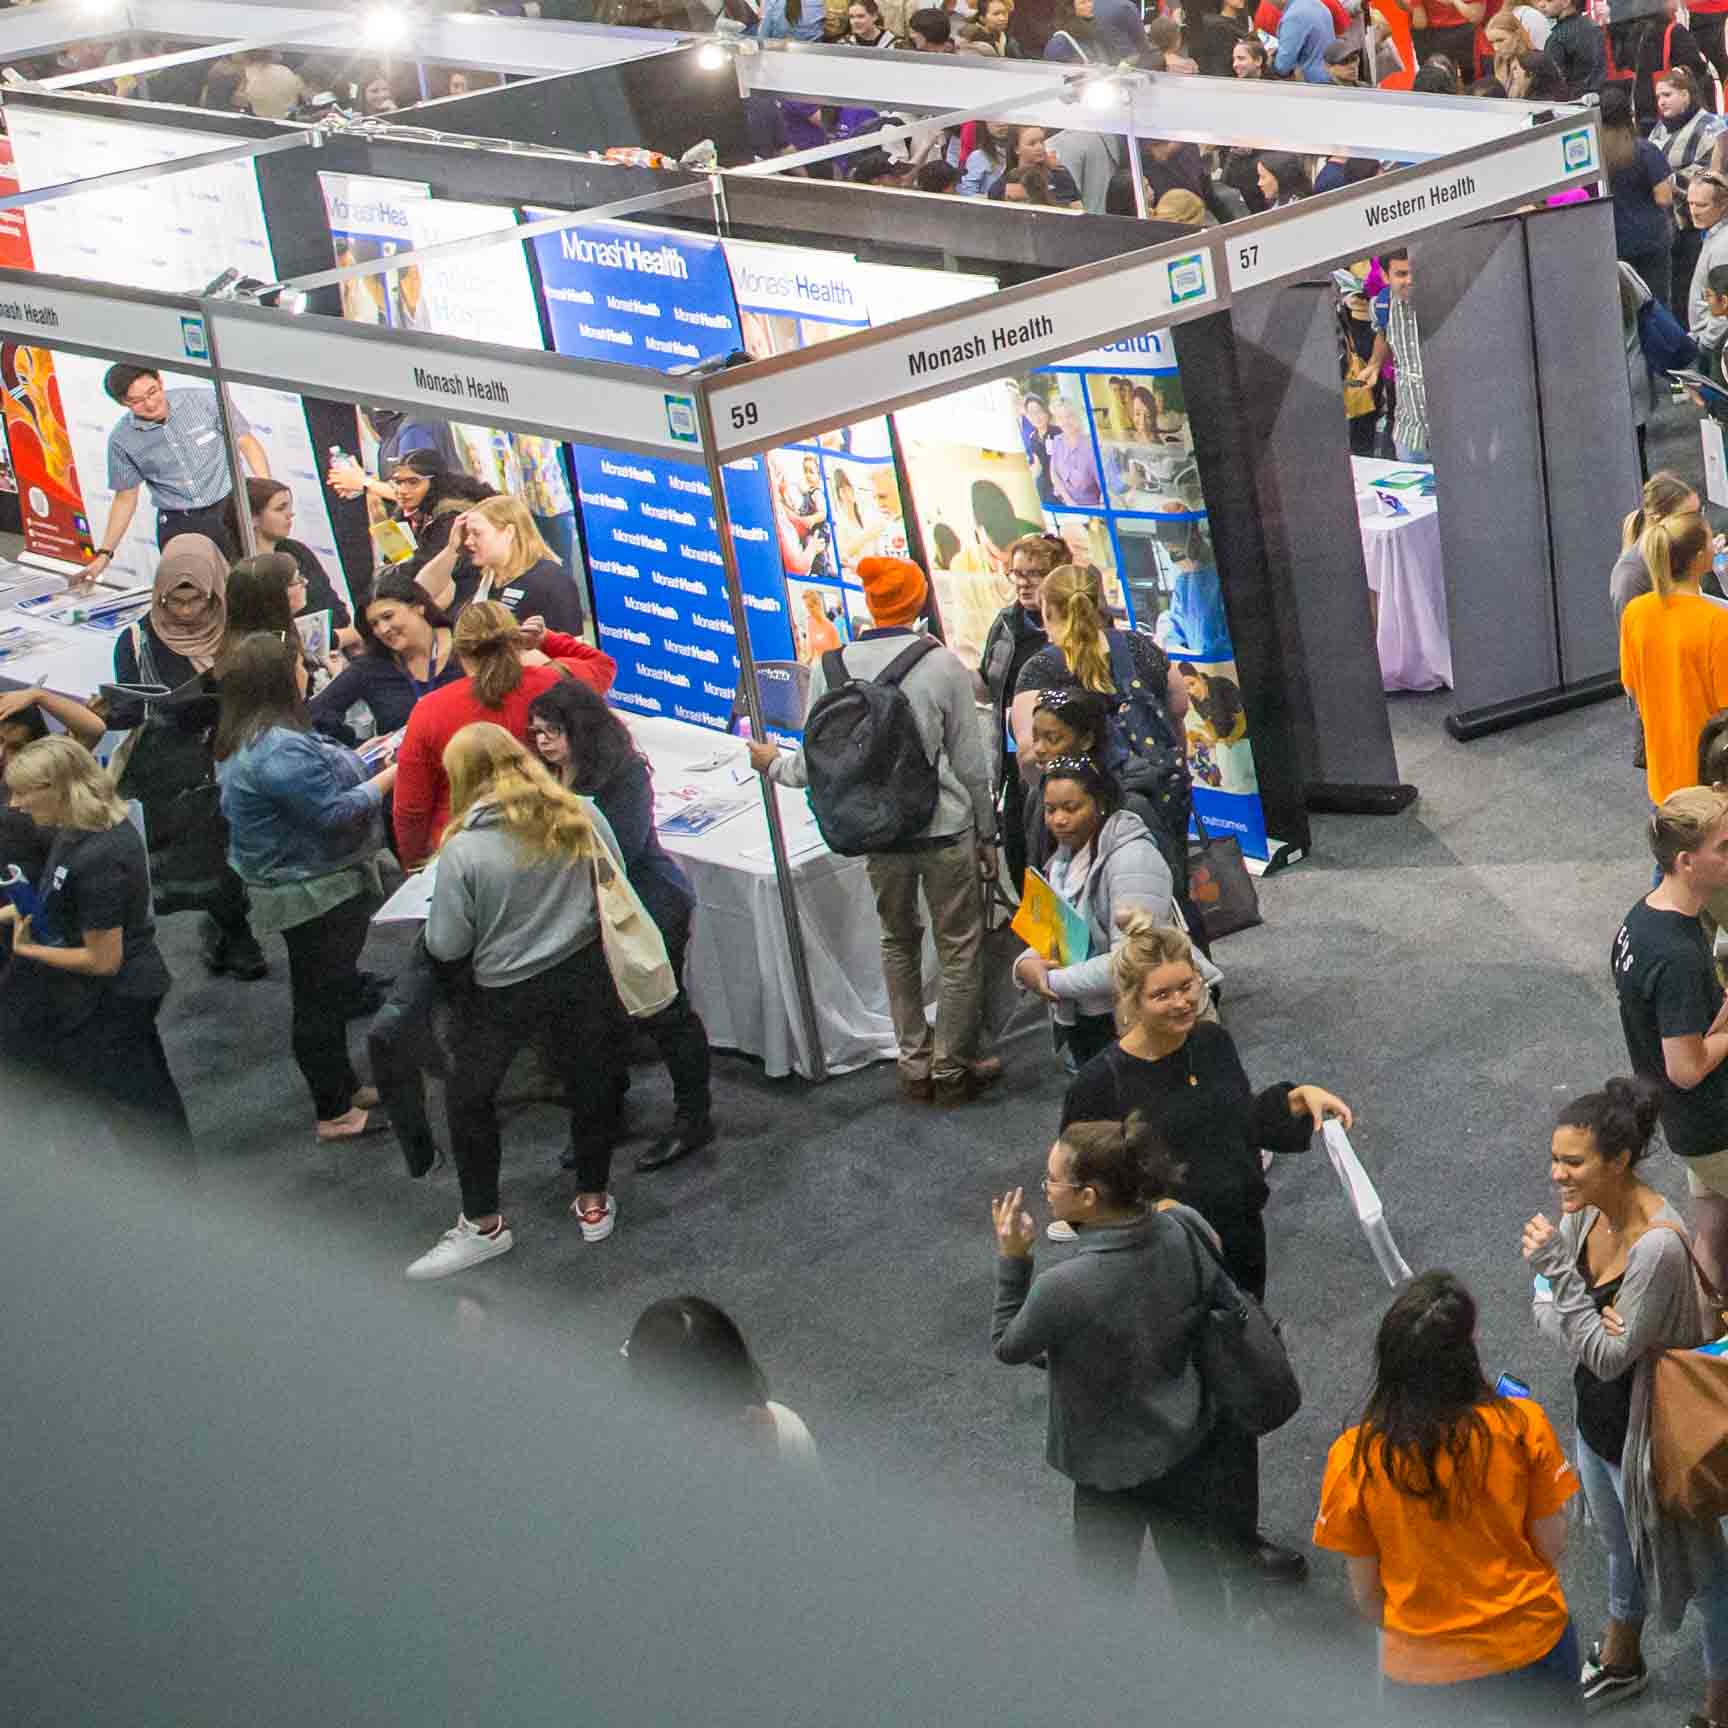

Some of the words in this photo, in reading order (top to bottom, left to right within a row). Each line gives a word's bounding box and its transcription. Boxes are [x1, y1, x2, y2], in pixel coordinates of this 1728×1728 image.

[1365, 196, 1426, 228] Western
[1429, 176, 1476, 207] Health
[560, 230, 689, 280] MonashHealth
[1239, 246, 1260, 270] 57
[24, 307, 59, 327] Health
[908, 335, 987, 377] Monash
[991, 315, 1054, 352] Health
[414, 367, 465, 397] Monash
[467, 376, 510, 403] Health
[730, 401, 760, 430] 59
